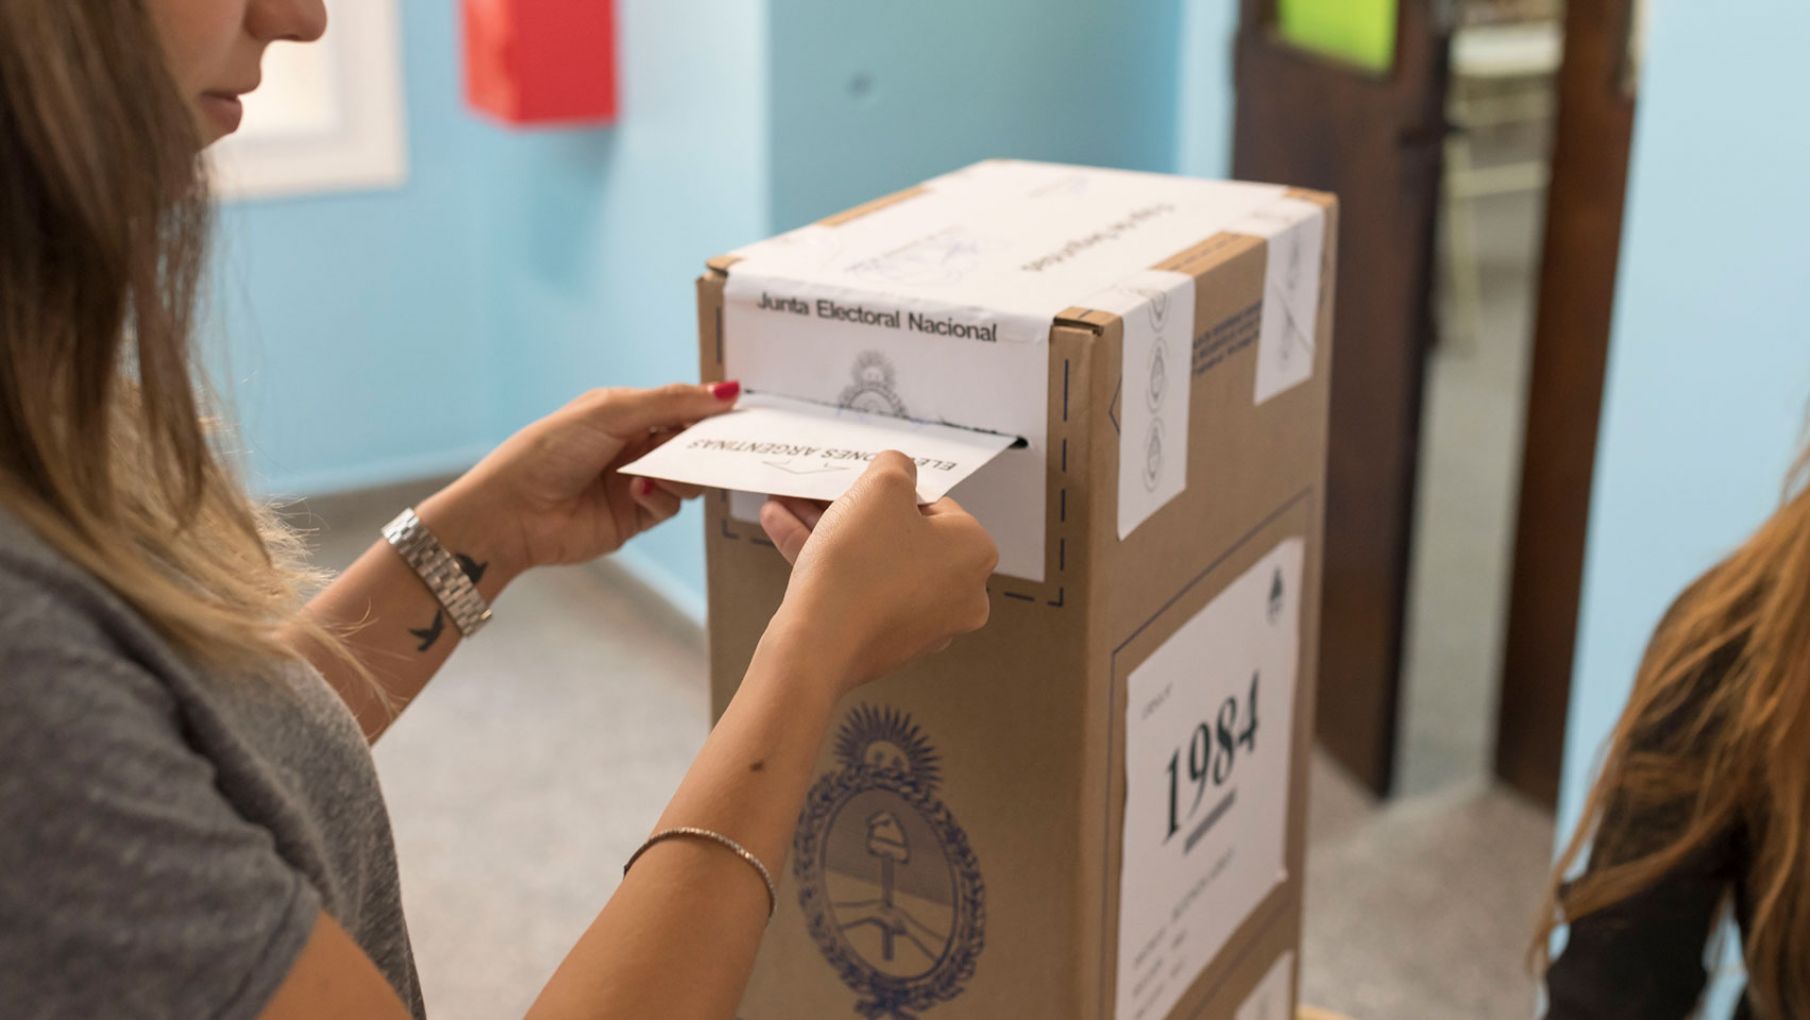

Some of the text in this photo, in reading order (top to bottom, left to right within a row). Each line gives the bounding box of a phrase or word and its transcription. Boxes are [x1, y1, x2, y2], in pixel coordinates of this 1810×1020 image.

[757, 292, 997, 342] Junta Electoral Nacional
[687, 438, 957, 471] ELEONES ARGENTINAS
[1163, 669, 1259, 844] 1984
